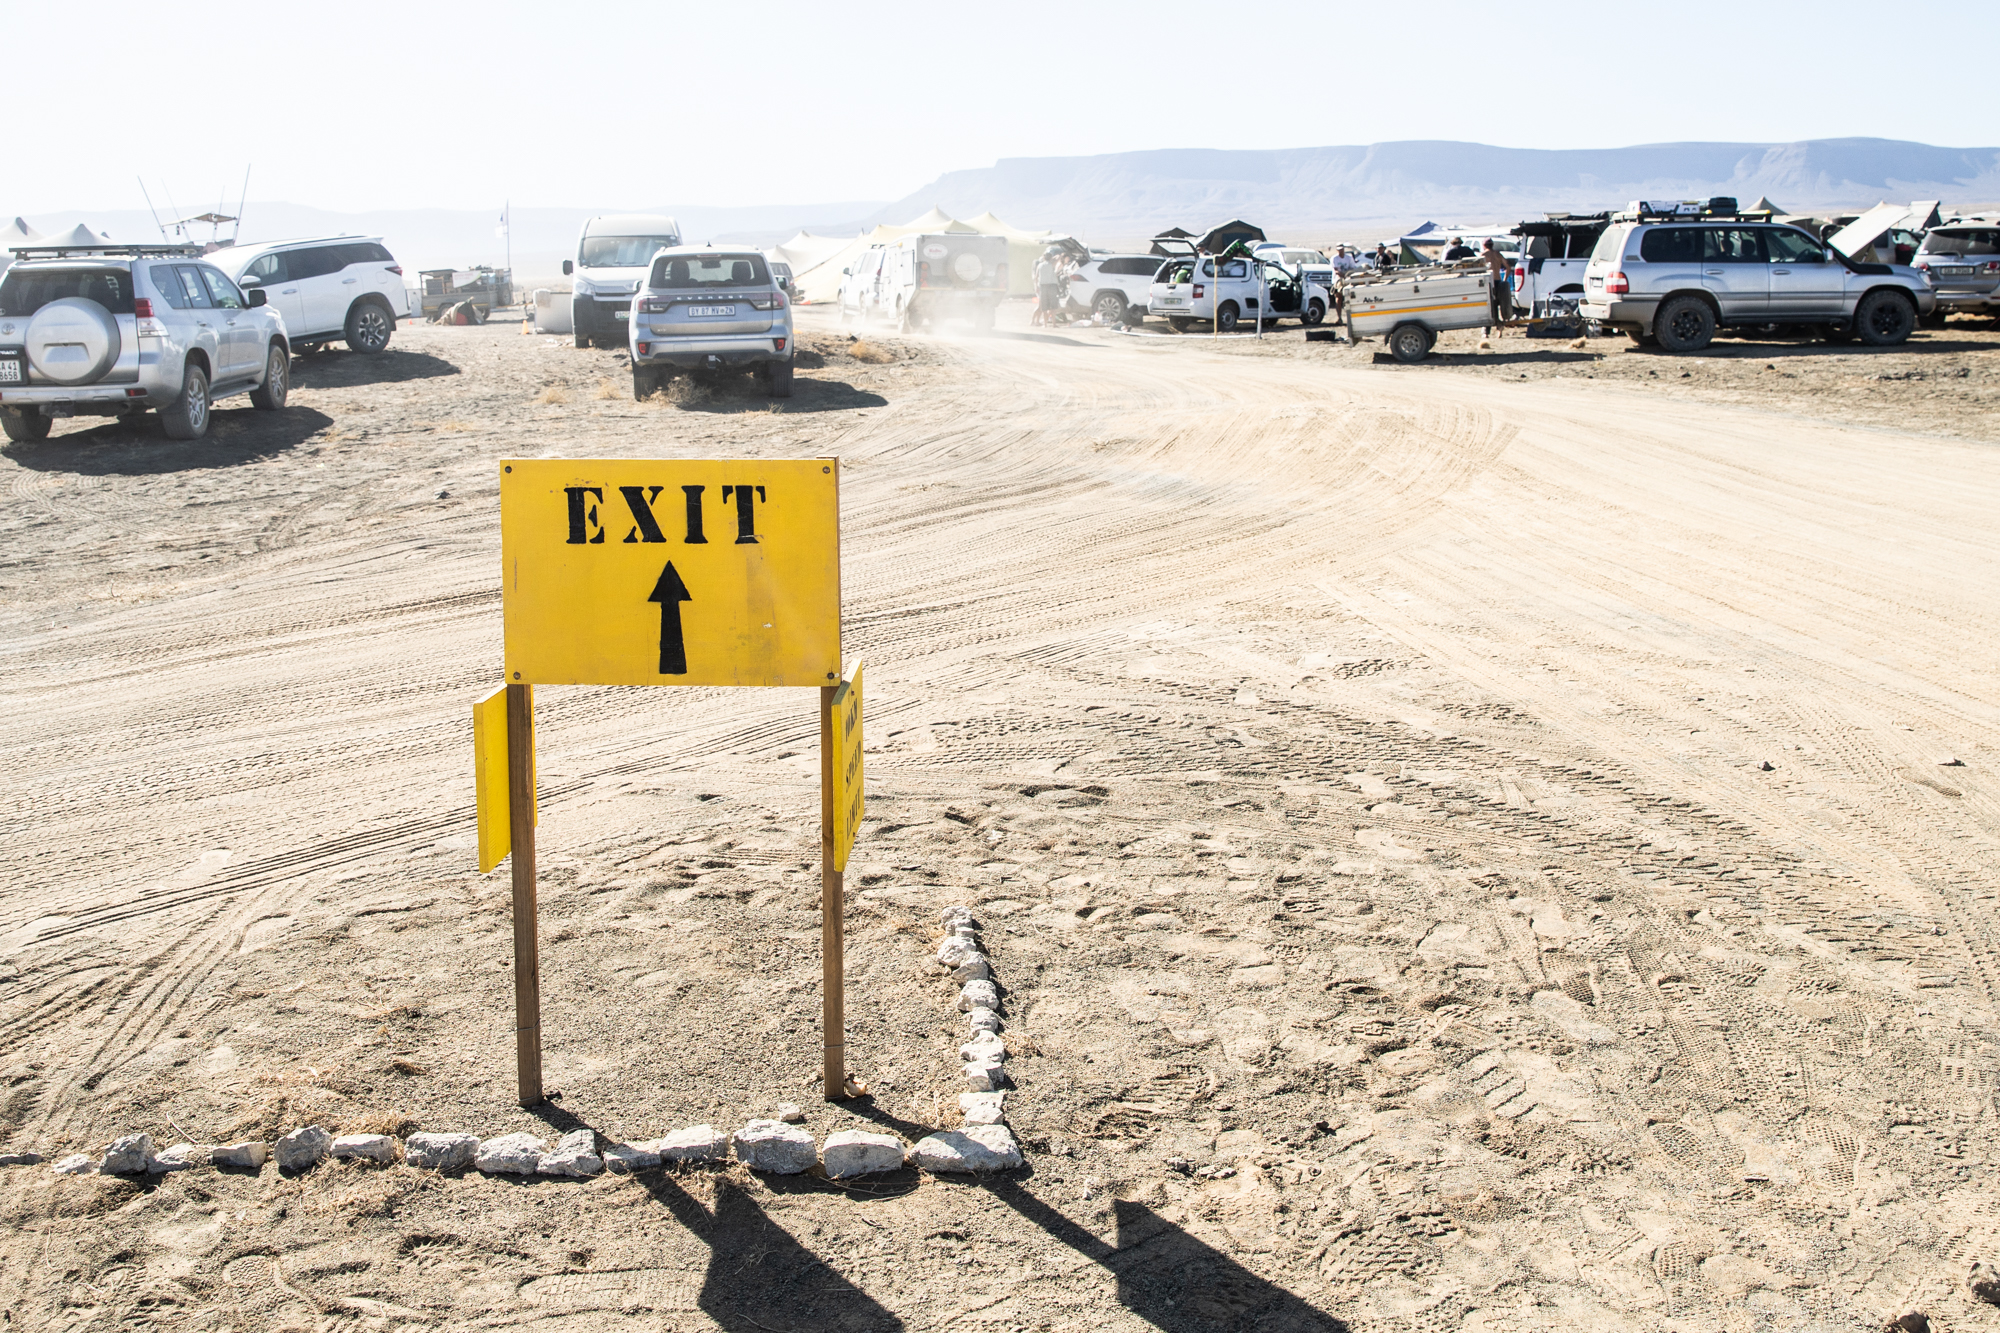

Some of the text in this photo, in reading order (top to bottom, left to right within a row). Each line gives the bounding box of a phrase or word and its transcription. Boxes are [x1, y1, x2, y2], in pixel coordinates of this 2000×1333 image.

[725, 306, 733, 314] ZN
[564, 485, 766, 544] EXIT
[845, 740, 861, 793] SPEED
[846, 786, 861, 840] LIMIT
